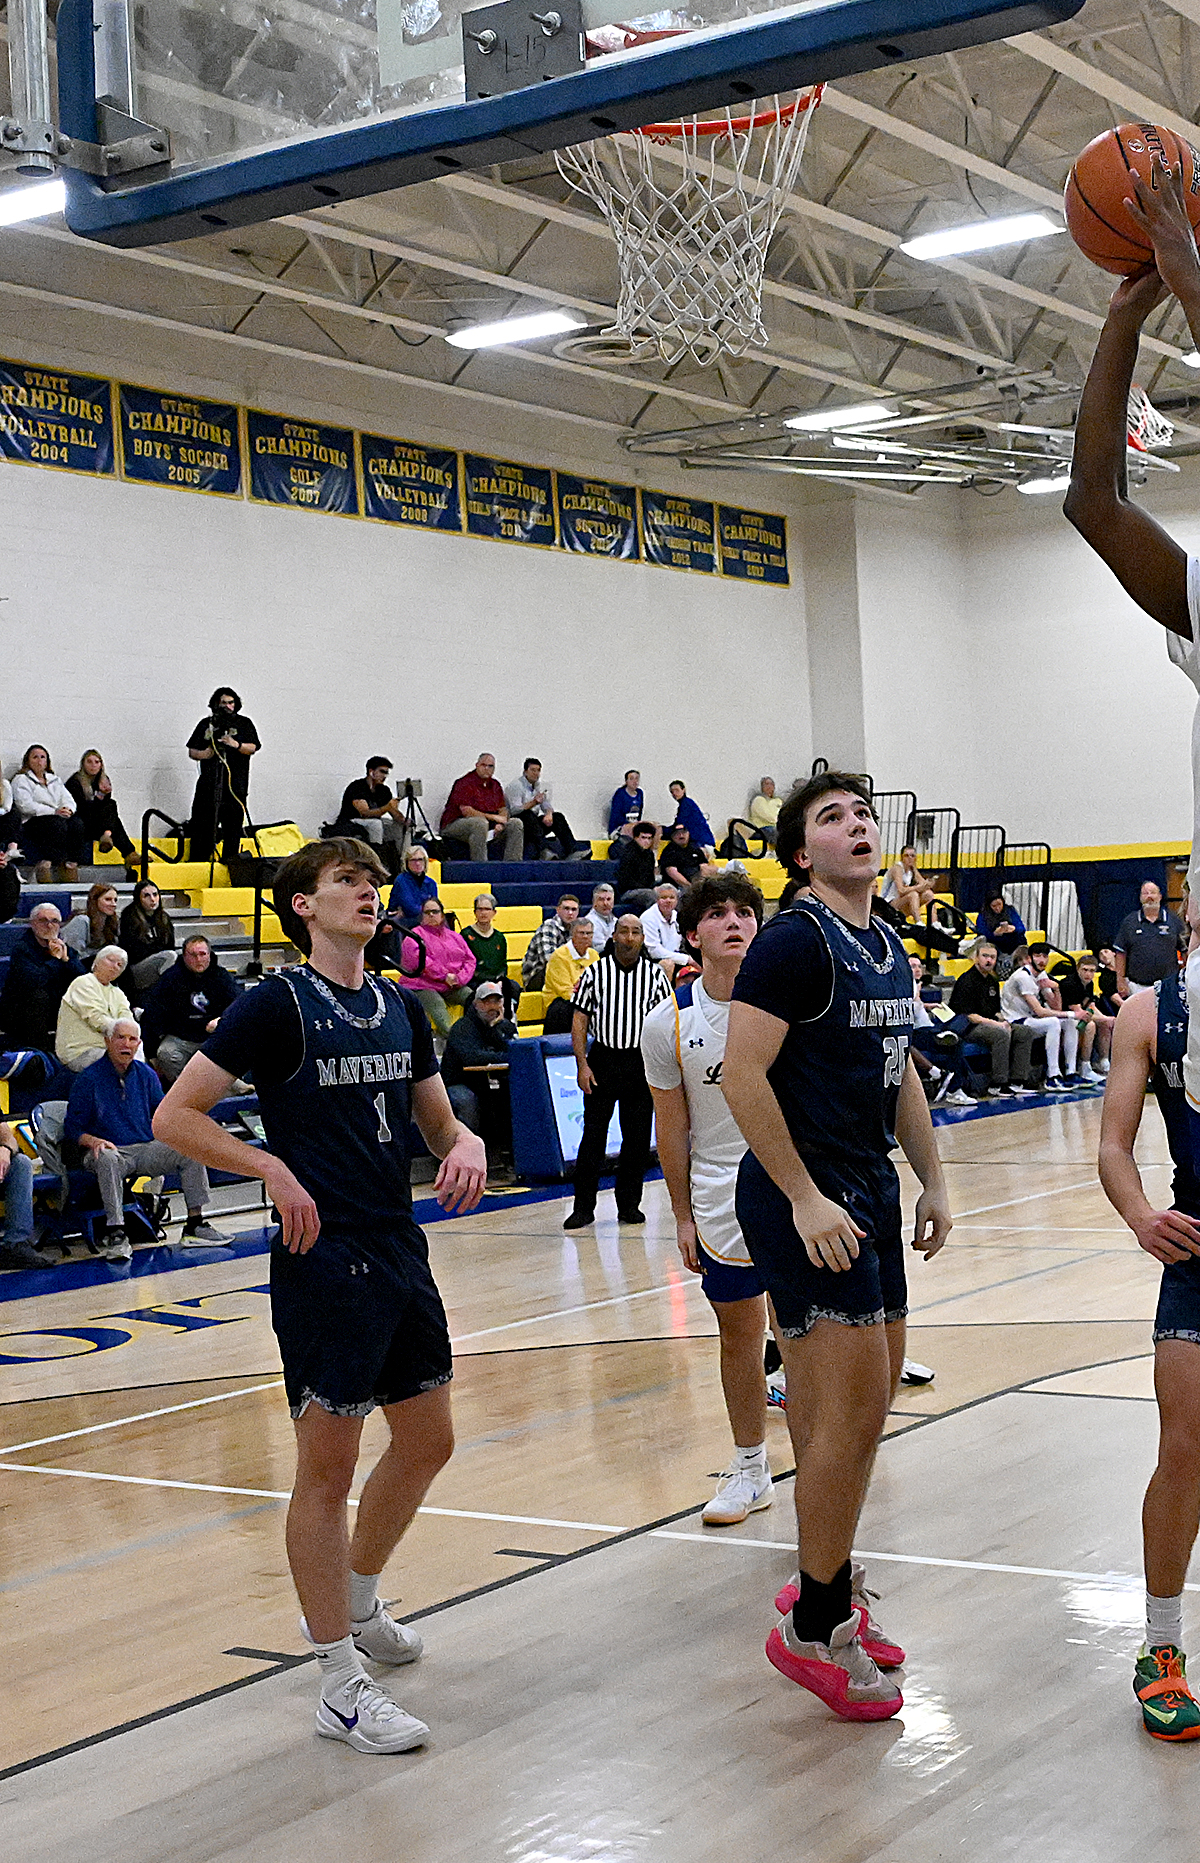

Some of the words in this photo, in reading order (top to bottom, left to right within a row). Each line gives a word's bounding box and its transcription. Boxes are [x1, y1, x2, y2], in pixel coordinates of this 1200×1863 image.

[24, 371, 68, 392] STATE
[0, 385, 103, 424] HAMPIONS
[161, 399, 201, 418] STATE
[129, 412, 231, 446] CHAMPIONS
[284, 424, 319, 441] STATE
[31, 442, 68, 463] 2004
[179, 447, 228, 470] SOCCER
[256, 437, 347, 469] CHAMPIONS
[395, 446, 427, 462] STATE
[168, 465, 200, 483] 2005
[369, 458, 452, 489] CHAMPIONS
[494, 465, 523, 480] STATE
[291, 487, 320, 504] 2007
[375, 483, 449, 509] VOLLEYBALL
[472, 477, 546, 505] CHAMPIONS
[563, 494, 633, 521] CHAMPIONS
[648, 509, 711, 536] CHAMPIONS
[725, 525, 782, 549] CHAMPIONS
[883, 1035, 908, 1088] 25
[374, 1092, 391, 1142] 1
